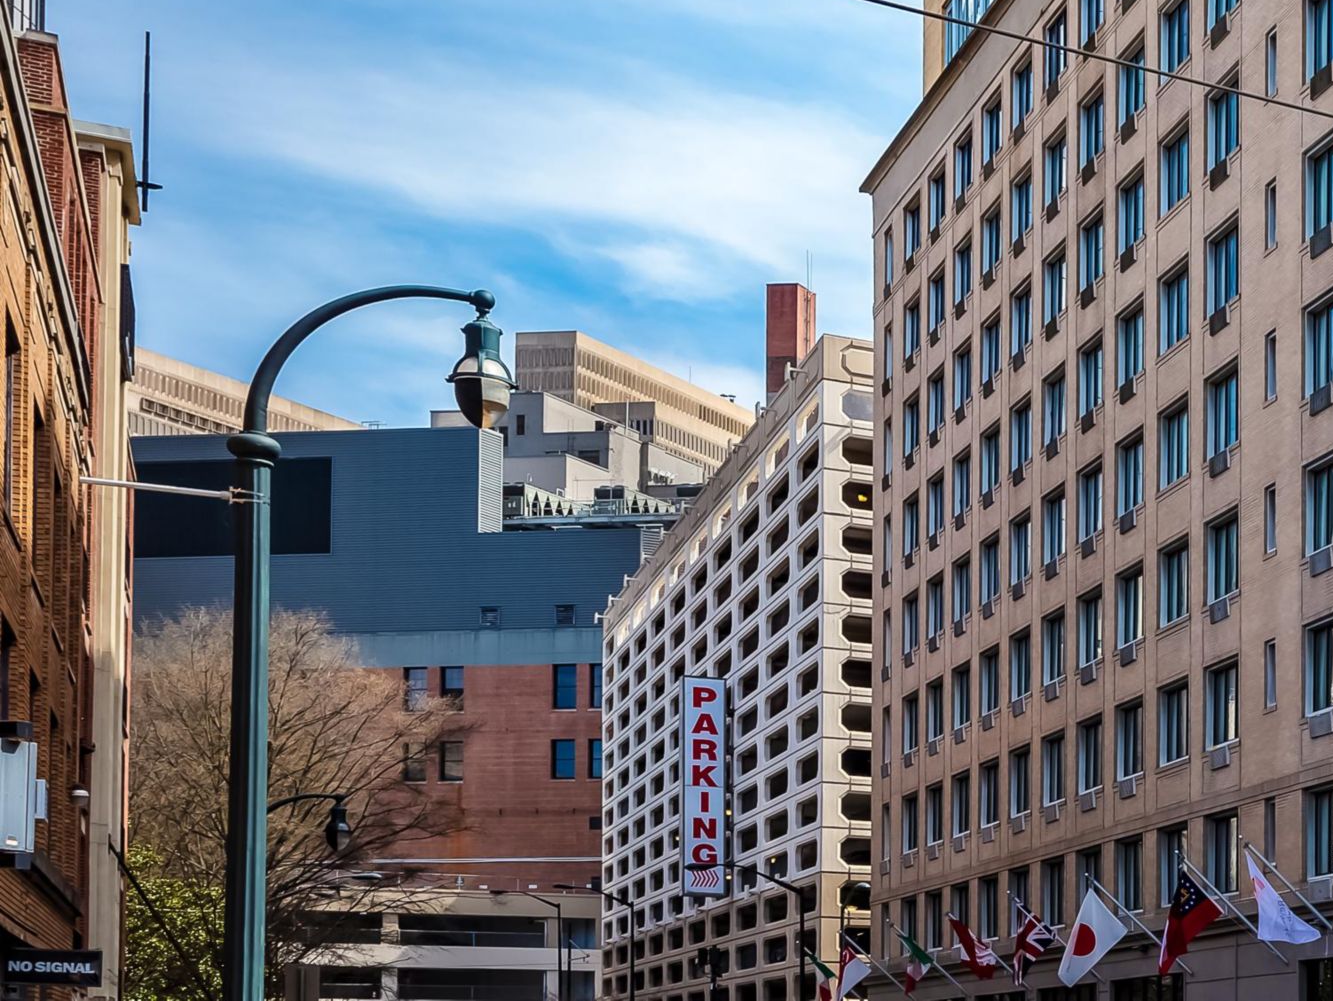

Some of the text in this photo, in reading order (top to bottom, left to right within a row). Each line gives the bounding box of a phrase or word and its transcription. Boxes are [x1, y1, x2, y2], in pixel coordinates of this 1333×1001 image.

[691, 686, 719, 865] PARKING
[8, 960, 96, 974] NO SIGNAL
